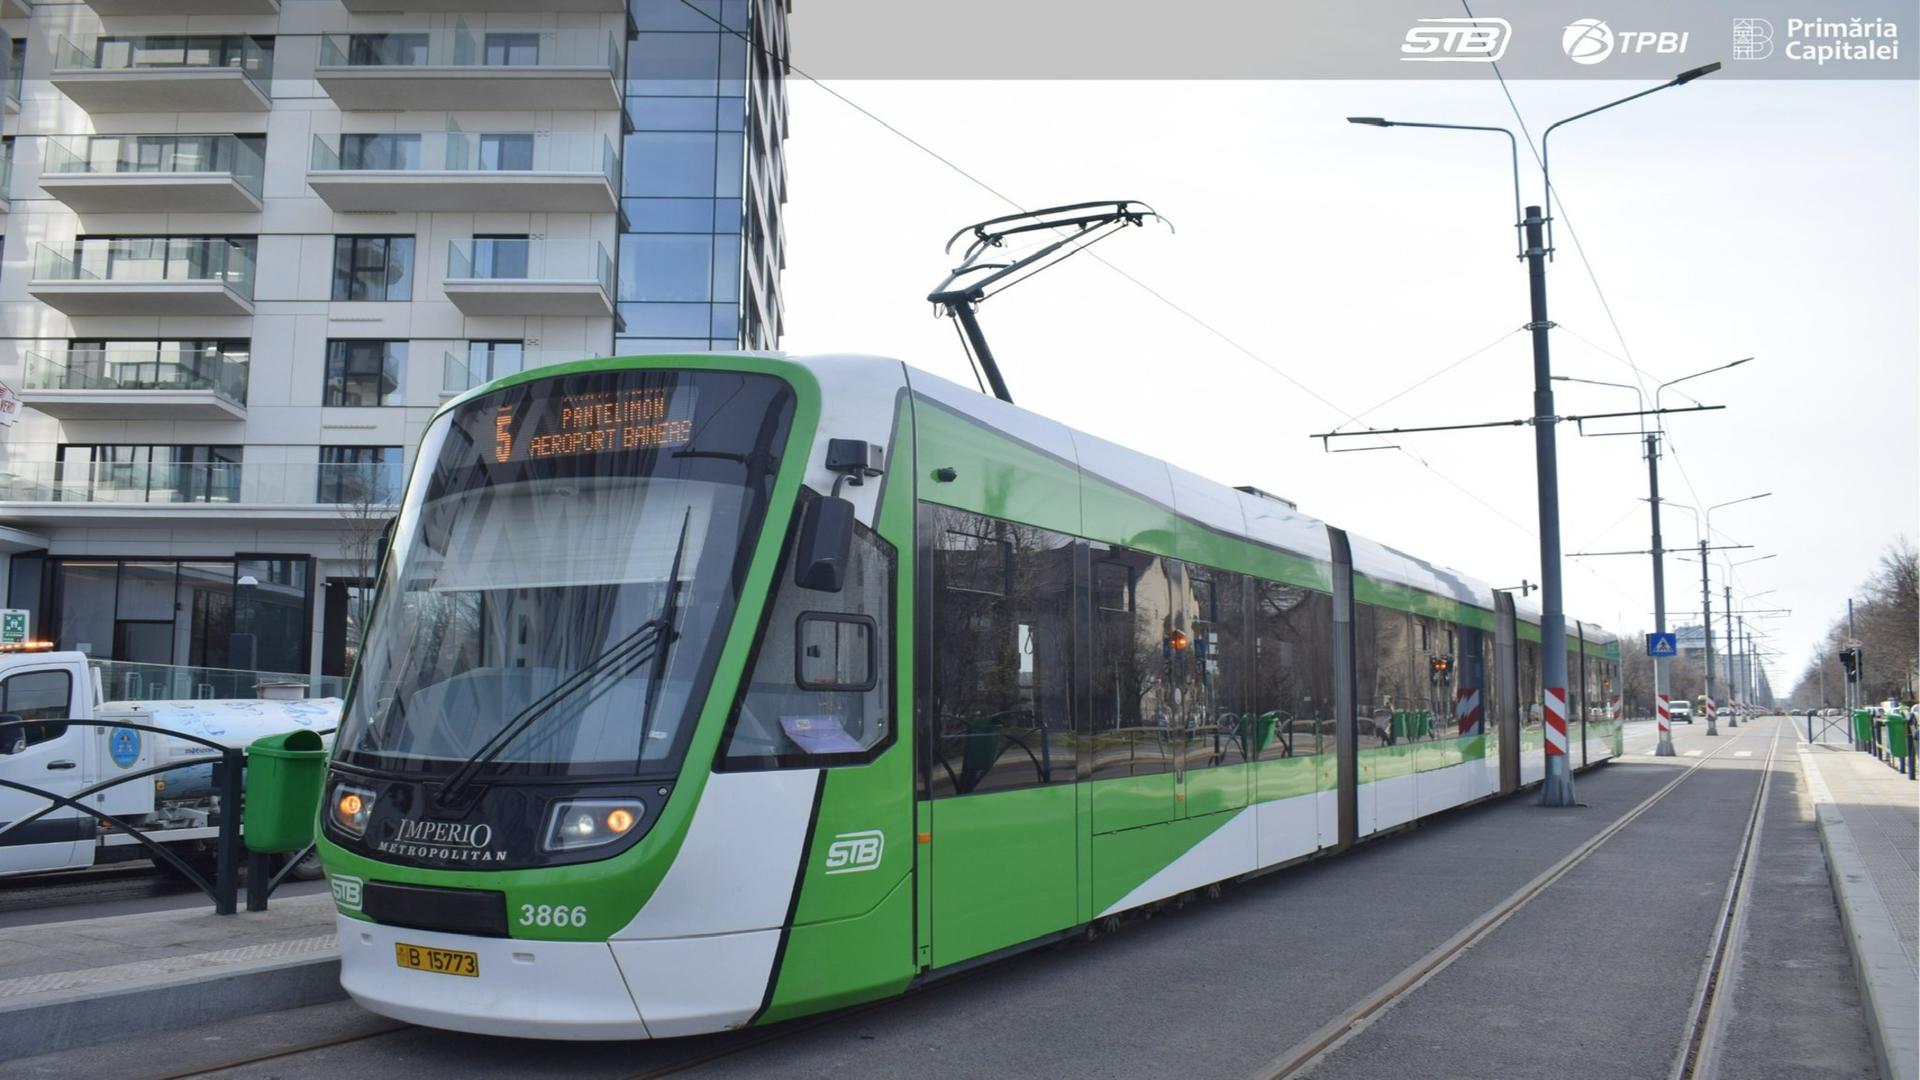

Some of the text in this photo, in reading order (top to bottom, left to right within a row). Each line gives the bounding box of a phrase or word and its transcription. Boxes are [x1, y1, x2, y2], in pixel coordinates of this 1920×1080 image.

[562, 397, 664, 429] PANTELIMON
[495, 414, 513, 463] 5
[530, 428, 617, 457] AEROPORT
[395, 819, 492, 848] IMPERIO
[378, 841, 507, 861] METROPOLITAN
[826, 837, 880, 867] STB
[330, 878, 361, 904] STB
[519, 903, 588, 928] 3866
[409, 947, 475, 974] B 15773
